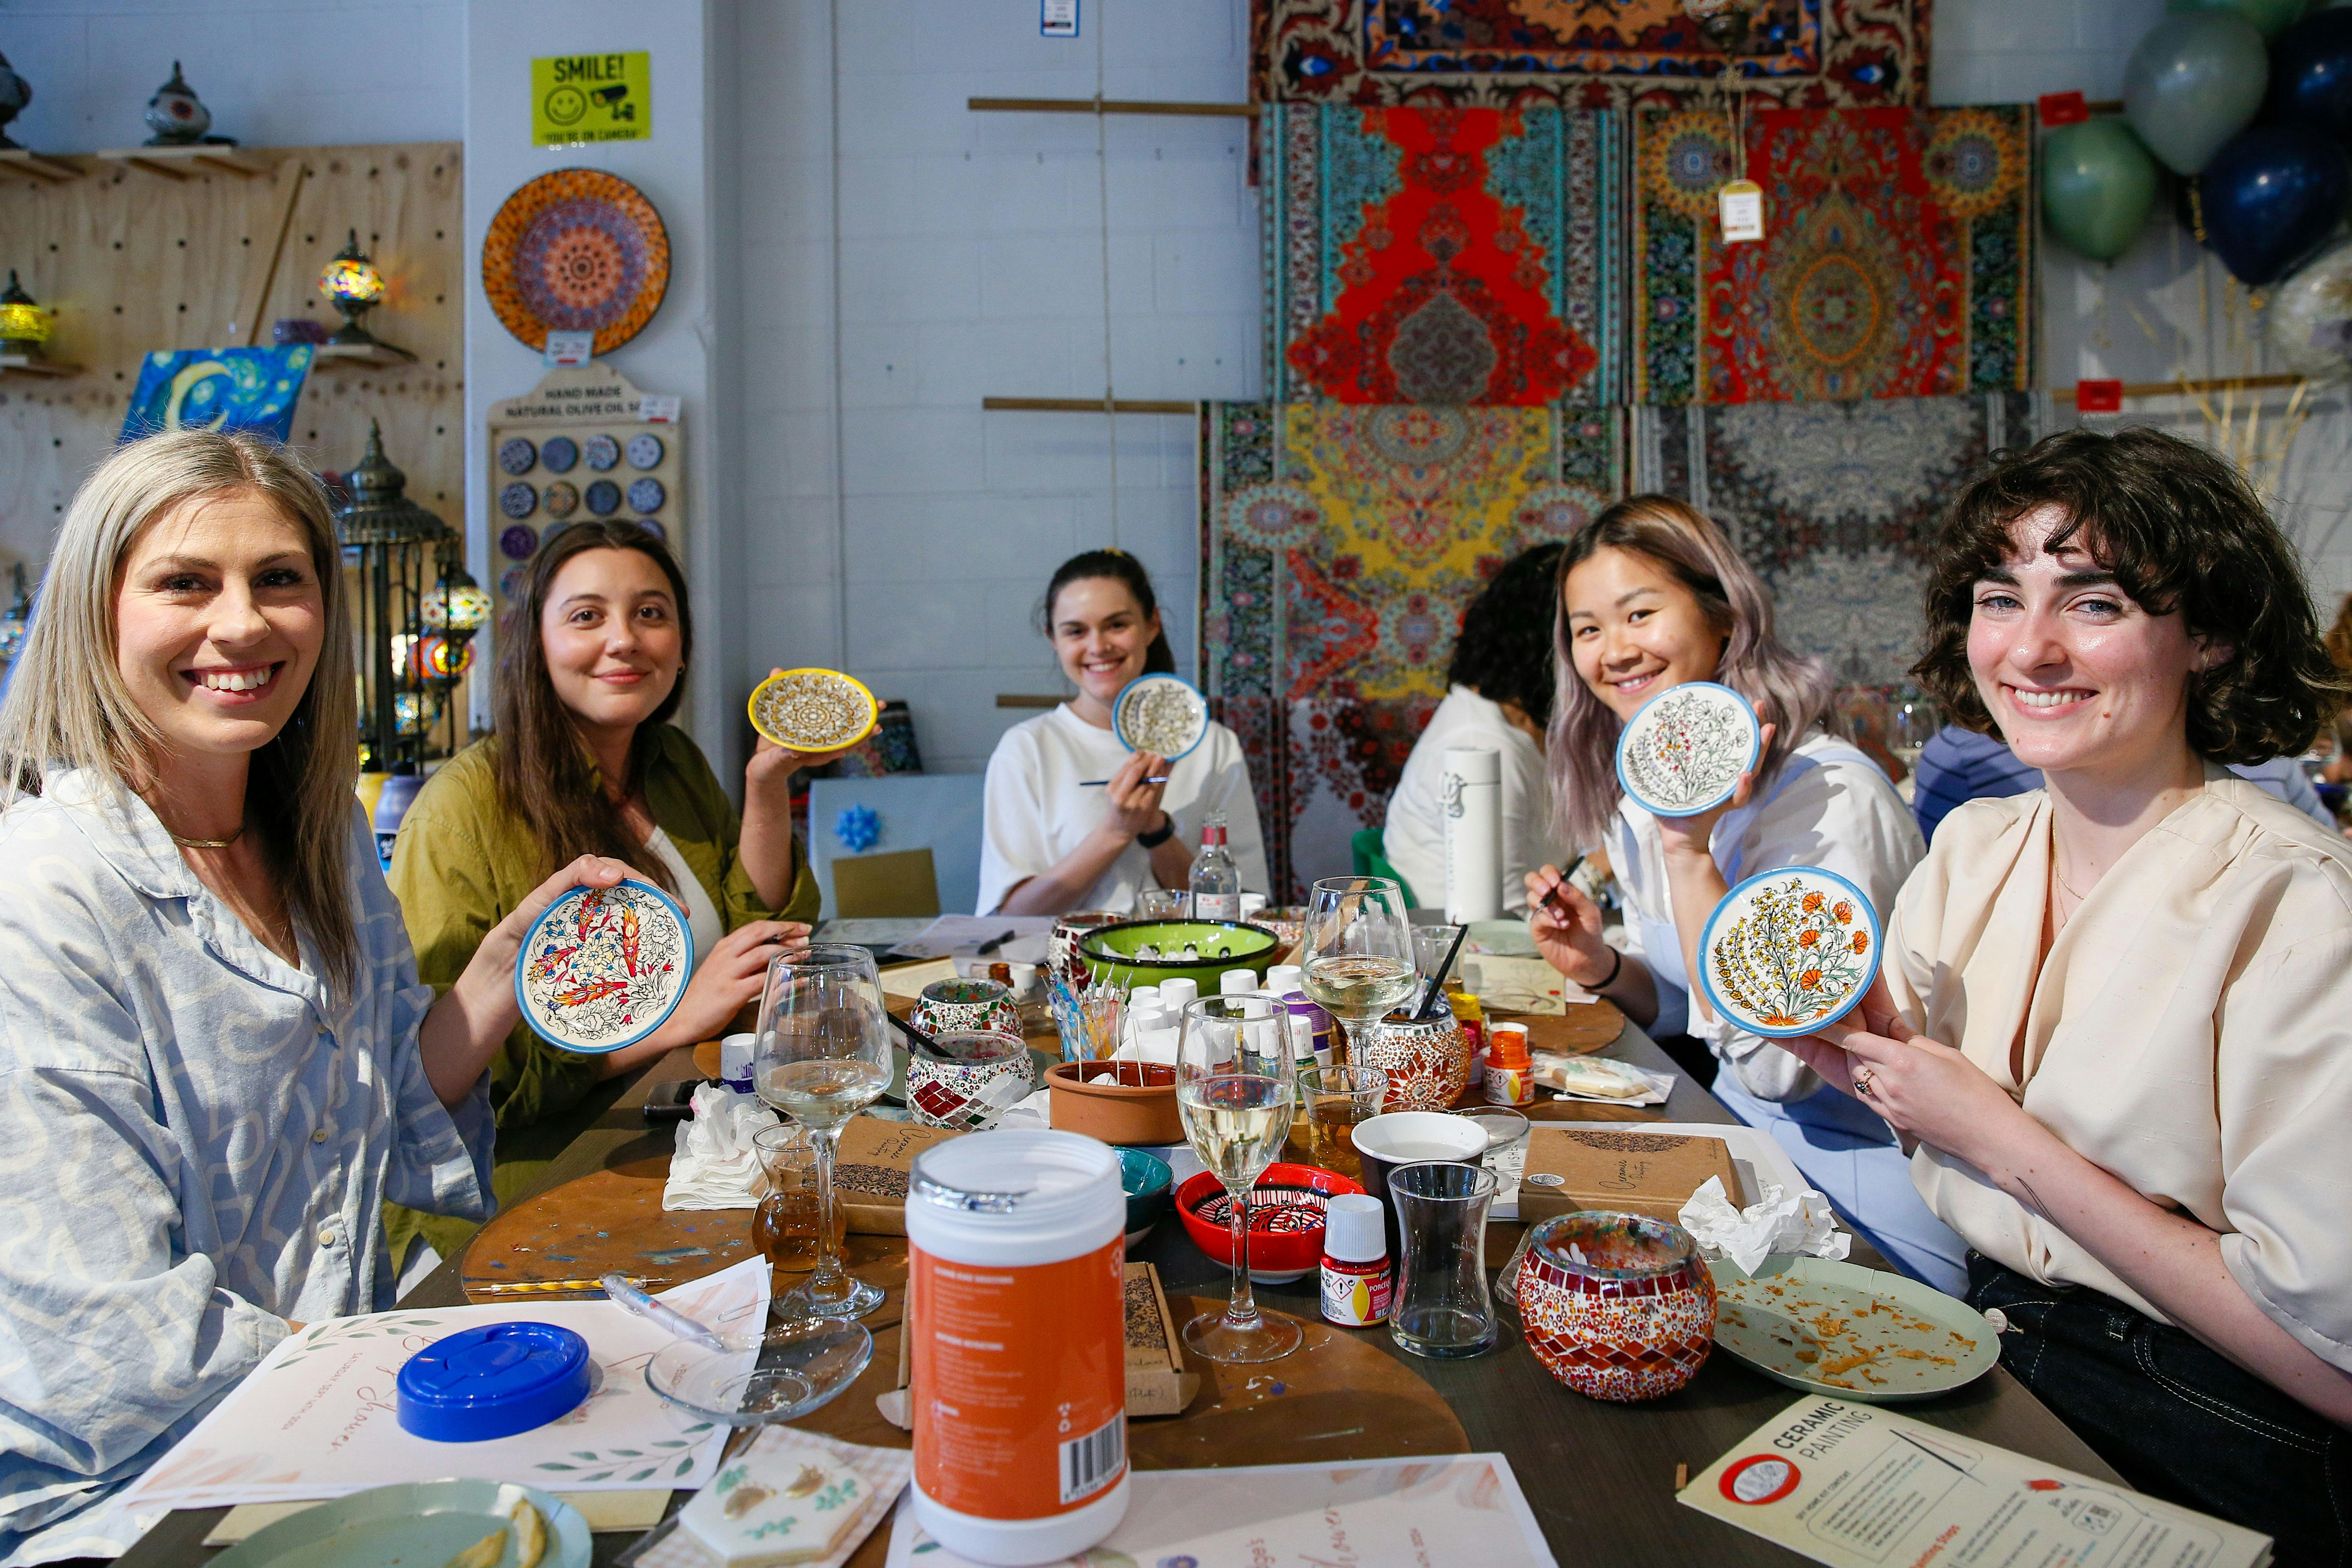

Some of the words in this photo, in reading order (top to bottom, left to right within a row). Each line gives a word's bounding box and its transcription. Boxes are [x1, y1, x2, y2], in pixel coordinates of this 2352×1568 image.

[554, 55, 624, 82] SMILE!
[544, 387, 583, 399] HAND
[585, 384, 621, 398] MADE
[506, 404, 562, 417] NATURAL
[565, 402, 601, 416] OLIVE
[604, 401, 624, 414] OIL
[1508, 1144, 1520, 1167] WISHE
[330, 1352, 363, 1382] SATURDAY
[1773, 1402, 1845, 1450] CERAMIC
[1799, 1411, 1873, 1461] PAINTING
